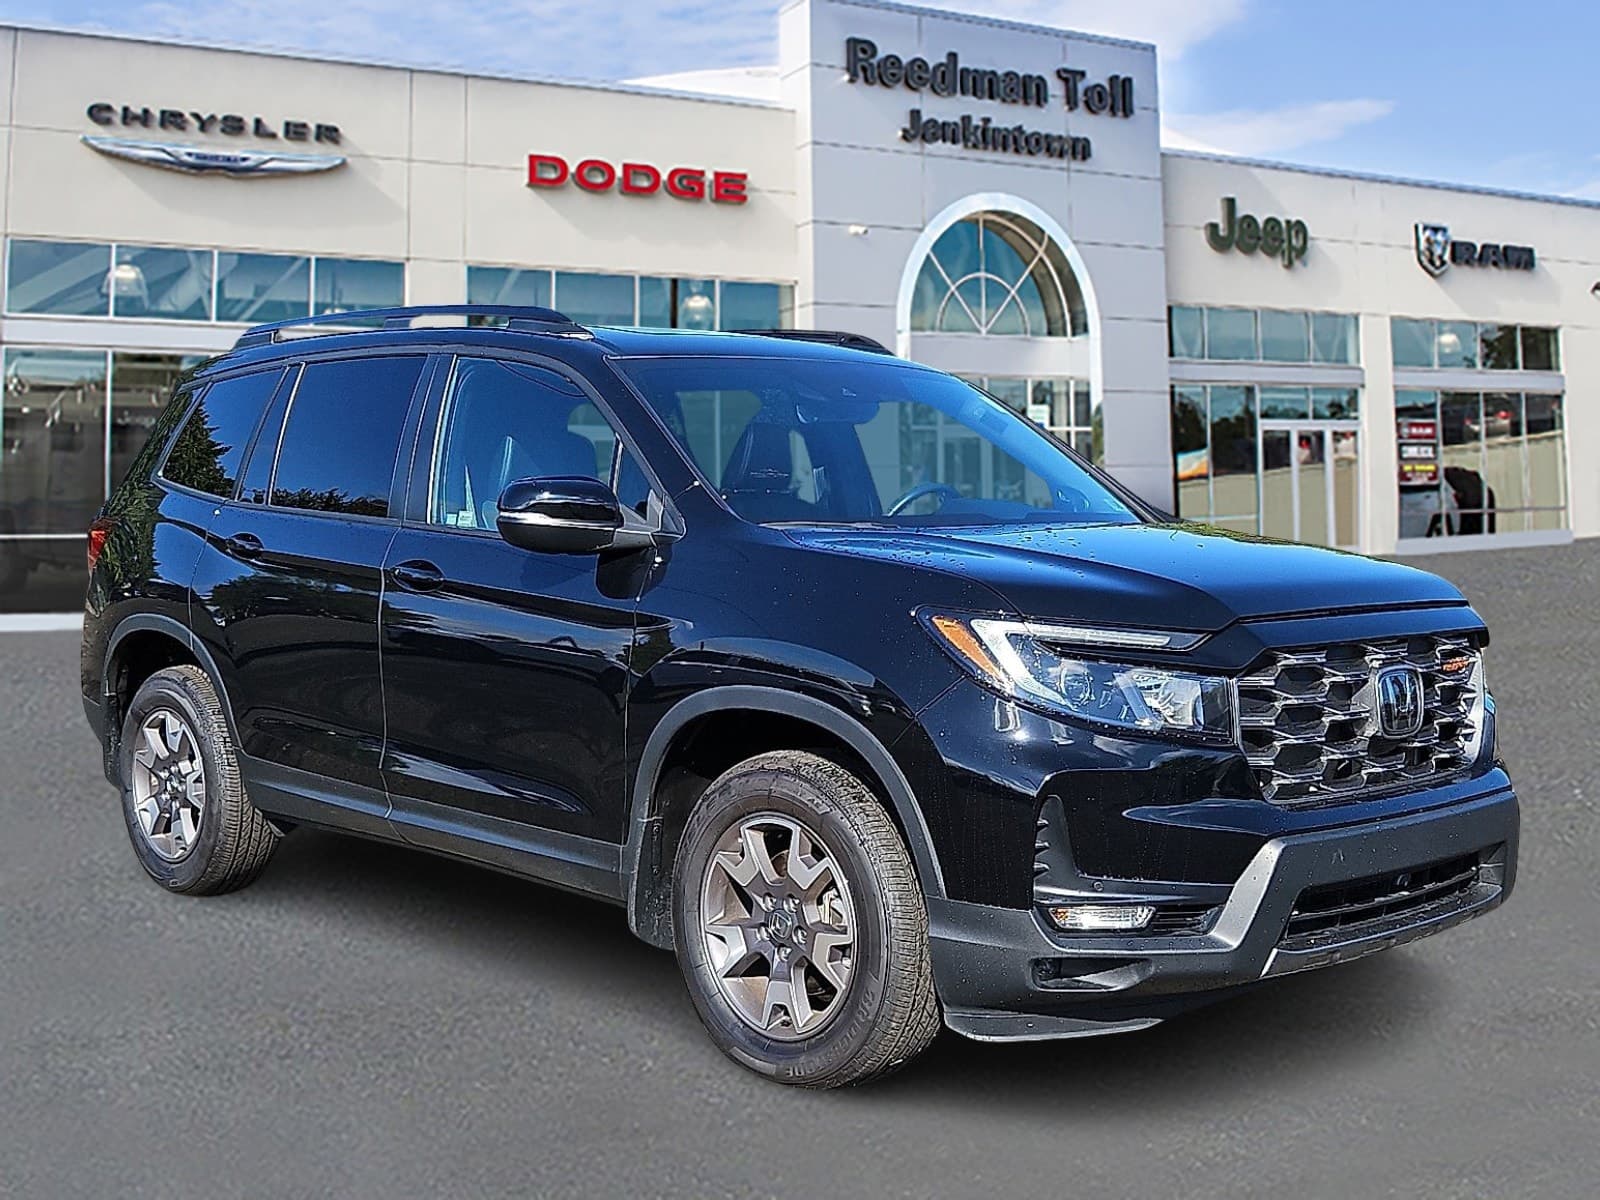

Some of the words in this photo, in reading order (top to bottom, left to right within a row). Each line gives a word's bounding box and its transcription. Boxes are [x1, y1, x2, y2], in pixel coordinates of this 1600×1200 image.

[845, 37, 1049, 108] Reedman
[1057, 68, 1135, 119] Toll
[87, 102, 342, 144] CHRYSLER
[900, 108, 1092, 161] Jenkintown
[527, 154, 749, 205] DODGE
[1205, 197, 1308, 269] Jeep
[1451, 240, 1535, 270] RAM
